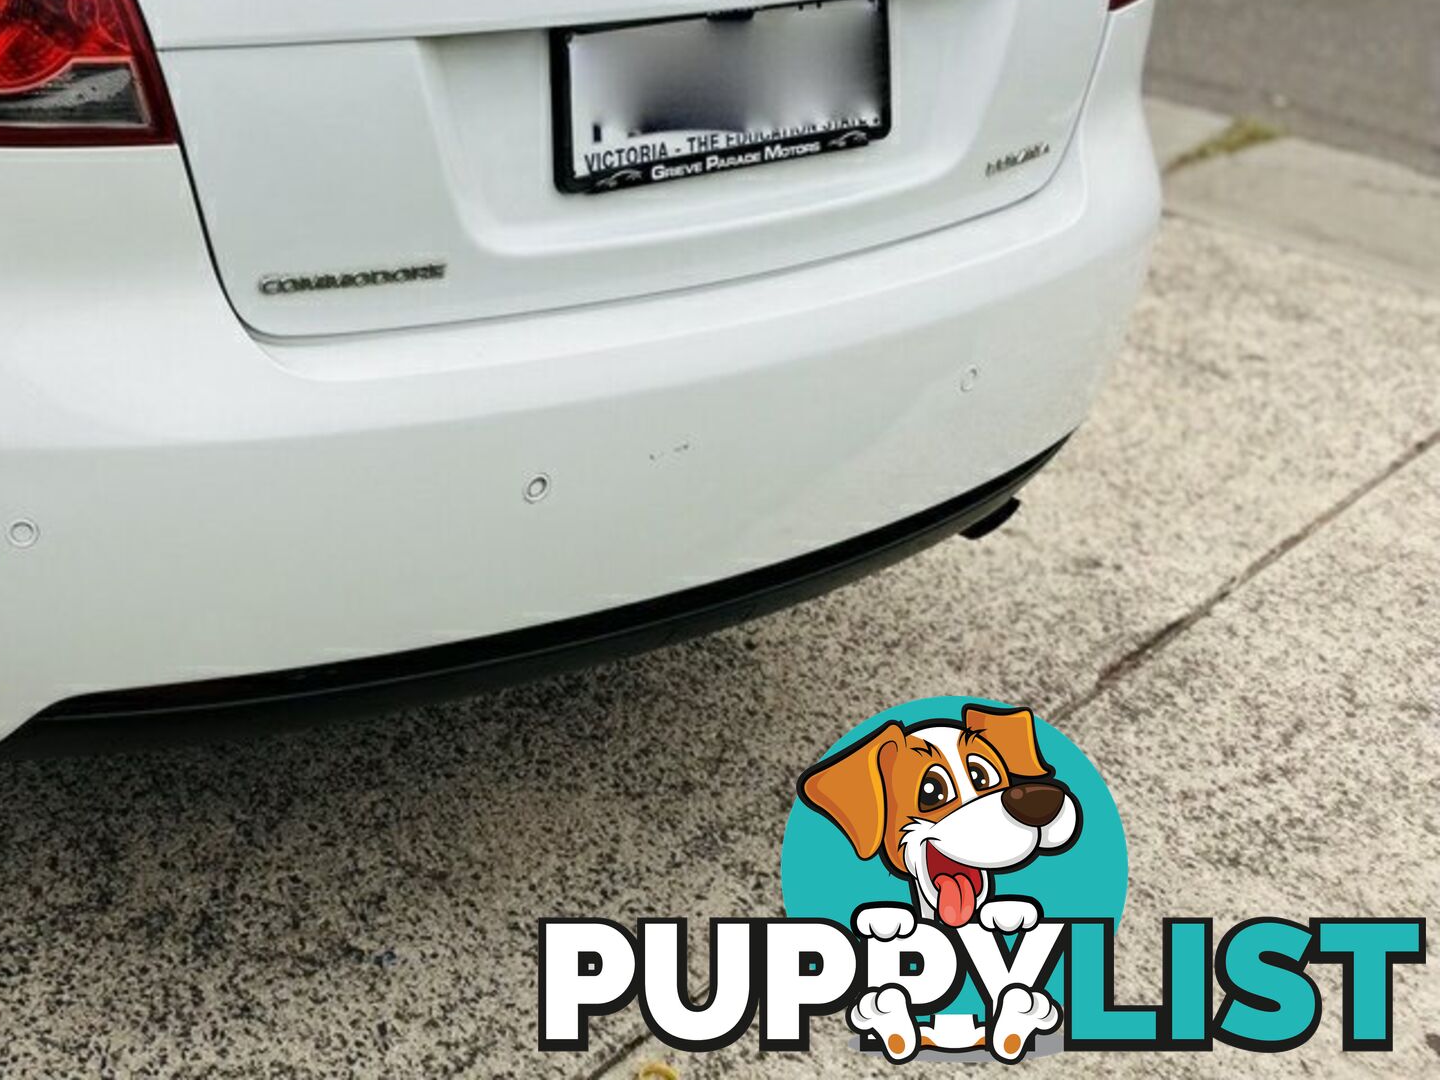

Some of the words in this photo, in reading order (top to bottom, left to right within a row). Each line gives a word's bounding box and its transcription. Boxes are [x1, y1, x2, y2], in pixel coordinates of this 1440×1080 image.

[584, 141, 668, 172] VICTORIA
[686, 131, 720, 154] THE
[764, 141, 821, 160] MOTORS
[260, 264, 446, 294] COMMODORE
